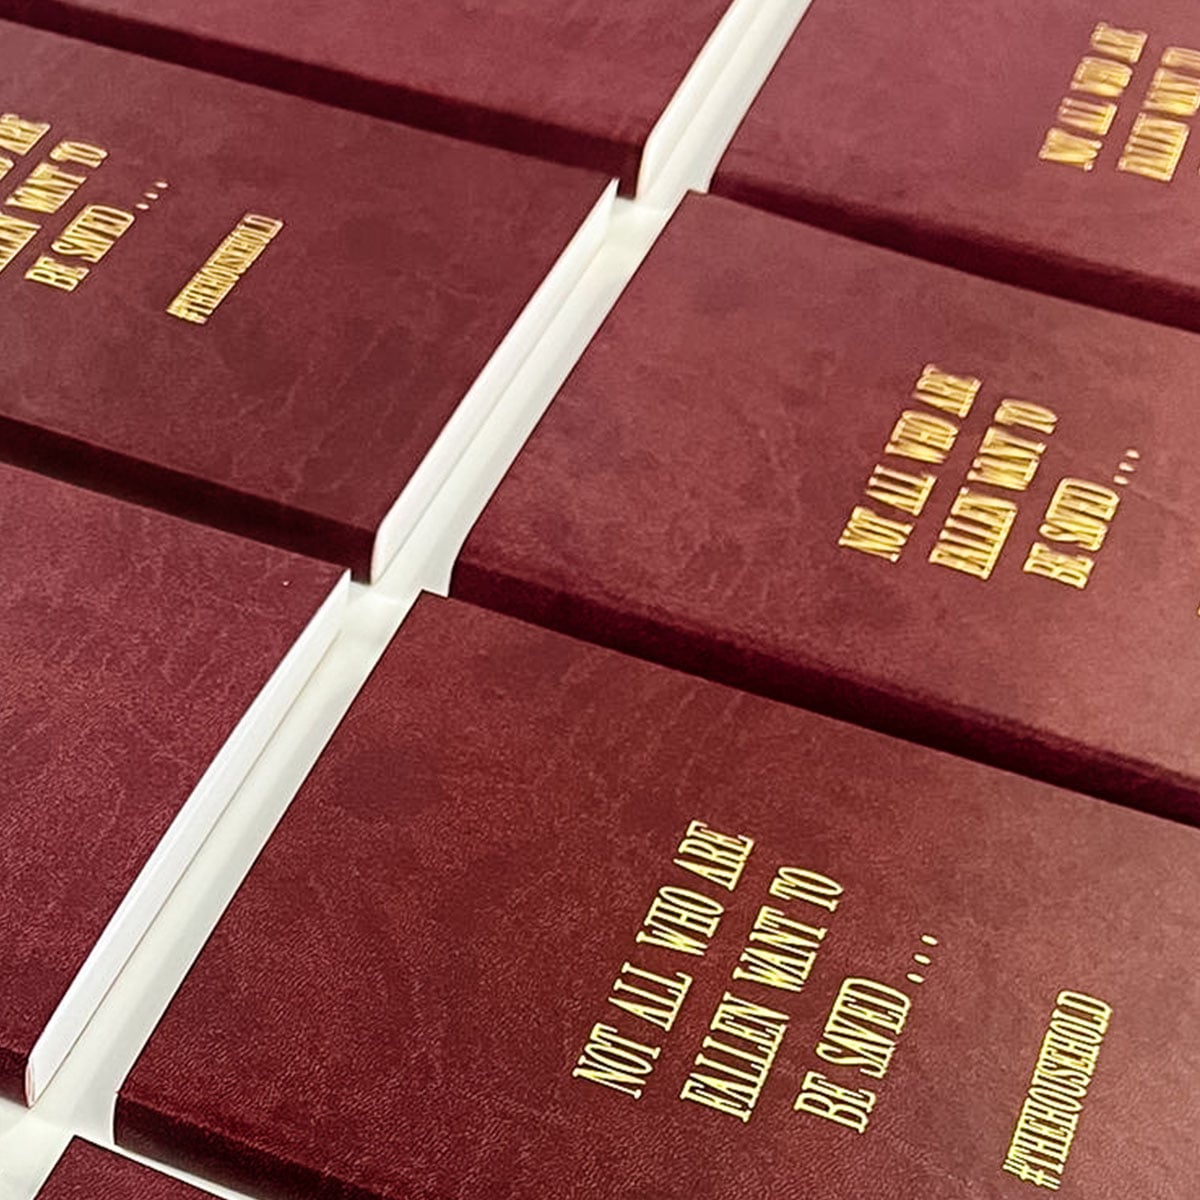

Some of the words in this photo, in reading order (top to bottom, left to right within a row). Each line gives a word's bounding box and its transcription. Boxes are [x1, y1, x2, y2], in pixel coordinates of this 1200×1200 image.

[4, 161, 88, 215] WANT
[49, 139, 109, 168] TO
[24, 255, 91, 293] BE
[165, 211, 285, 326] #THEHOUSEHOLD
[673, 819, 755, 891] ARE
[769, 866, 845, 912] TO
[636, 885, 725, 956] WHO
[732, 904, 828, 993] WANT
[607, 961, 693, 1032] ALL
[572, 1021, 662, 1100] NOT
[679, 991, 791, 1124] FALLEN
[1002, 988, 1114, 1191] #THEHOUSEHOLD
[793, 1070, 878, 1134] BE
